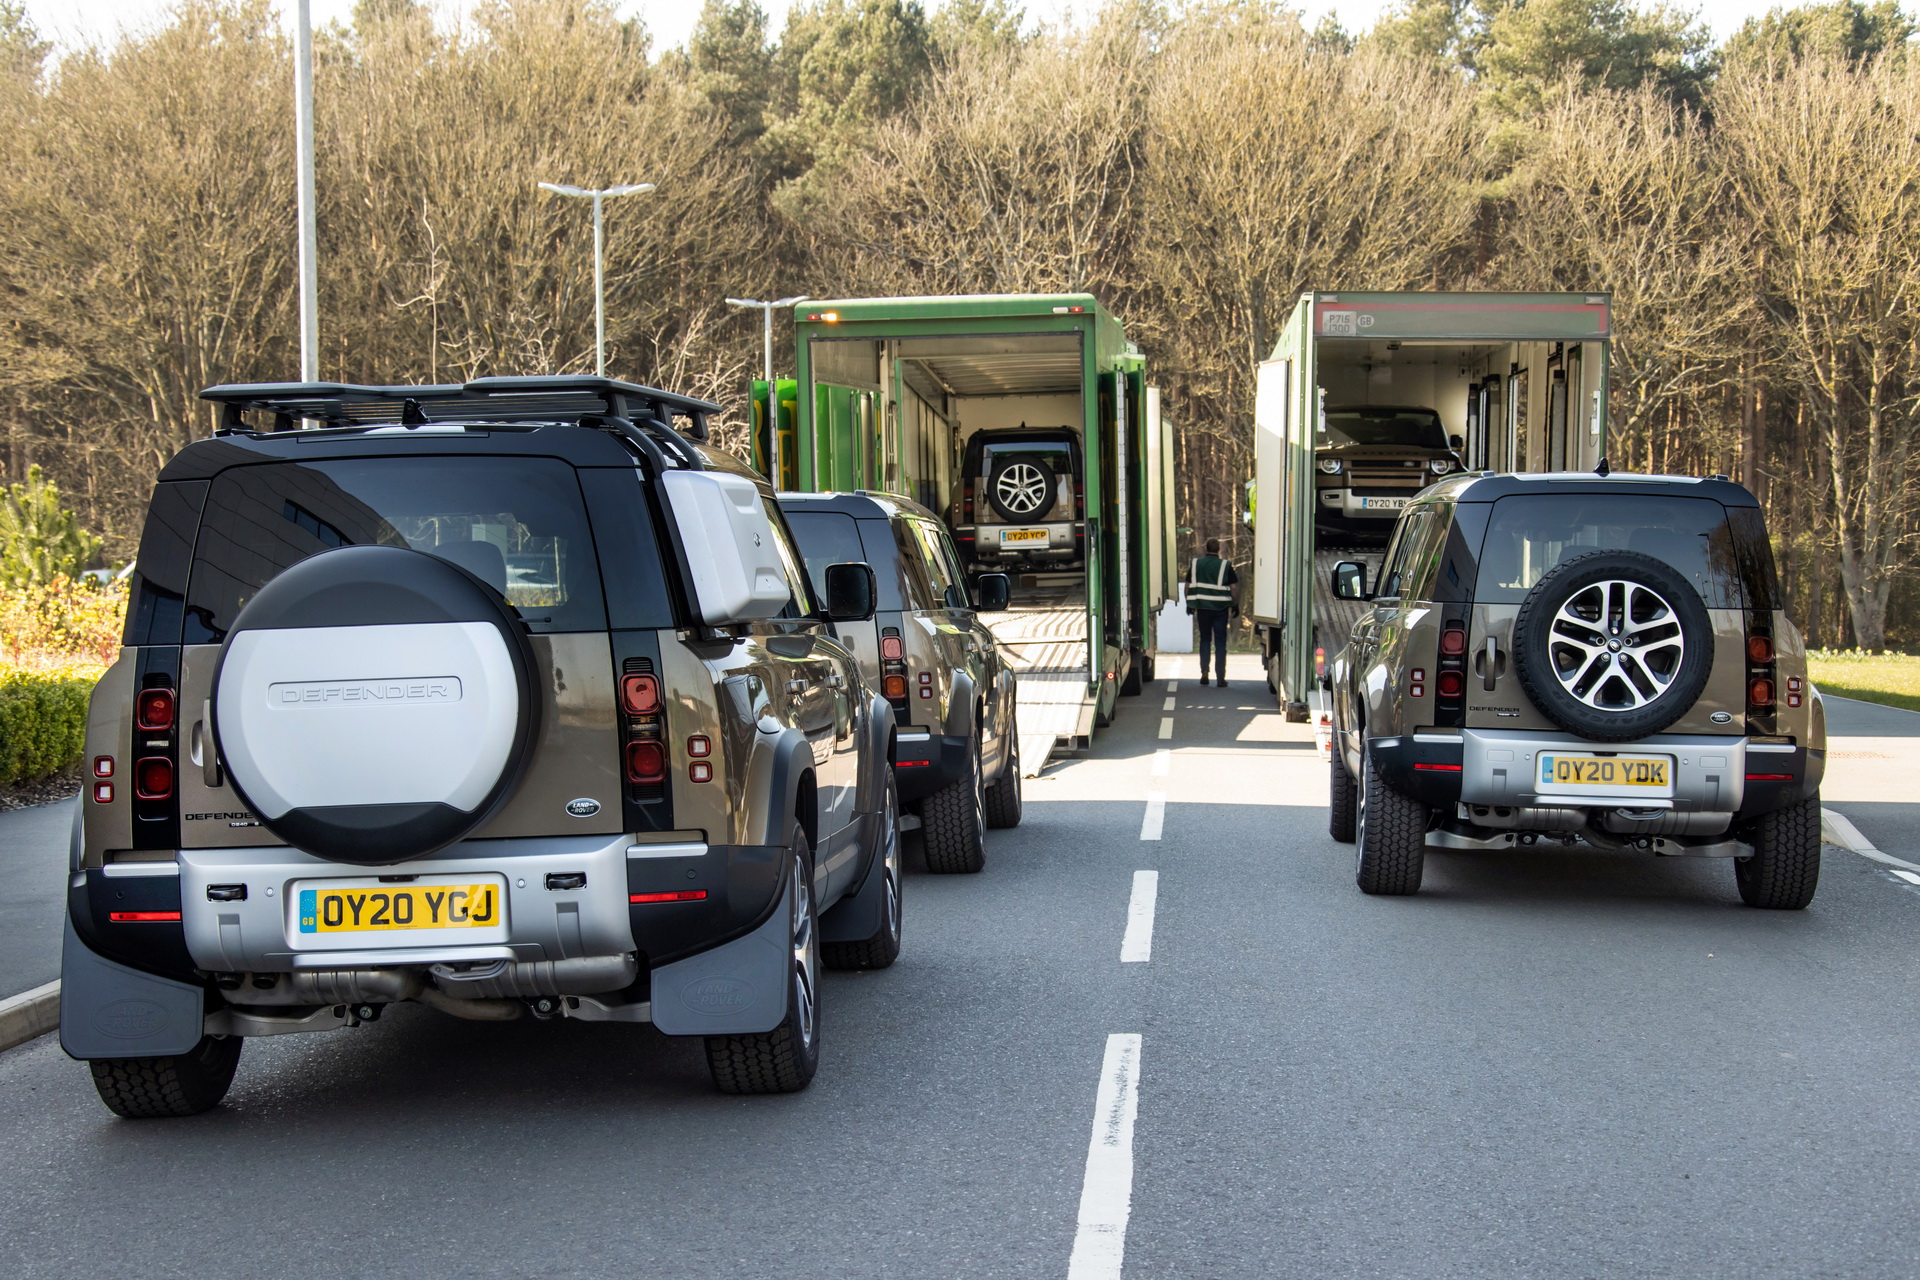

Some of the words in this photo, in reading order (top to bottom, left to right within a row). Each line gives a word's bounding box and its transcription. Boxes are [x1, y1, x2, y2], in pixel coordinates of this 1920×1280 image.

[1360, 316, 1372, 326] GB
[1368, 499, 1390, 508] OY20
[1007, 532, 1028, 541] OY20
[282, 683, 448, 703] DEFENDER
[1557, 760, 1614, 782] OY20
[1621, 762, 1664, 783] YDK
[185, 812, 254, 821] DEFENDE
[323, 892, 413, 927] OY20
[425, 890, 492, 924] YGJ
[302, 917, 314, 926] GB
